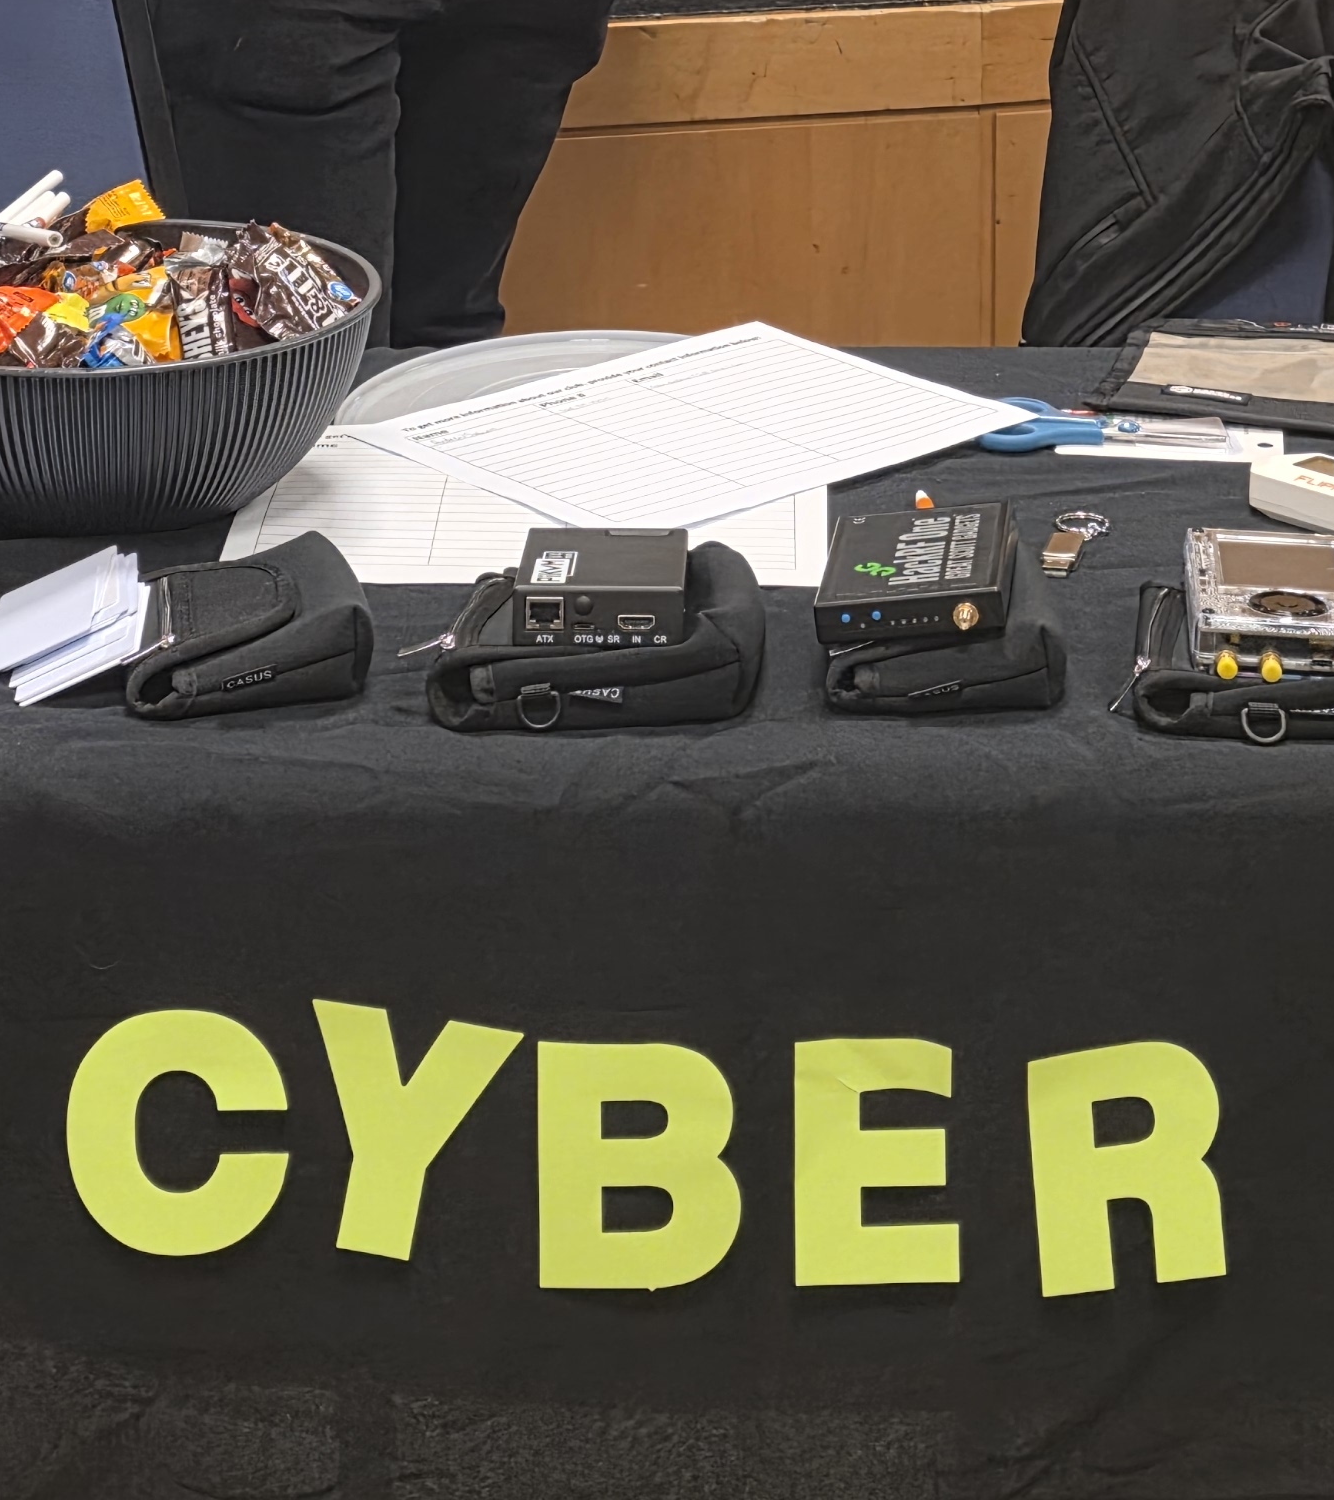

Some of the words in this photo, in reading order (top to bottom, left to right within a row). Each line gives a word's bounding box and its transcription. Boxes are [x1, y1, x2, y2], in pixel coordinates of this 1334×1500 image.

[434, 415, 460, 424] more
[460, 401, 517, 417] information
[678, 344, 731, 360] information
[412, 429, 450, 441] Name
[539, 395, 577, 407] Phone
[631, 372, 665, 383] Email
[897, 516, 951, 542] One
[953, 513, 981, 541] GADGETS
[948, 539, 977, 560] SCOTT
[888, 541, 946, 586] HackRF
[944, 559, 974, 580] GREAT
[535, 634, 554, 644] ATX
[574, 634, 594, 644] OTG
[607, 634, 620, 644] SR
[632, 634, 642, 644] IN
[653, 634, 667, 644] CR
[226, 669, 272, 689] CASUS
[66, 998, 1228, 1298] CYBER
